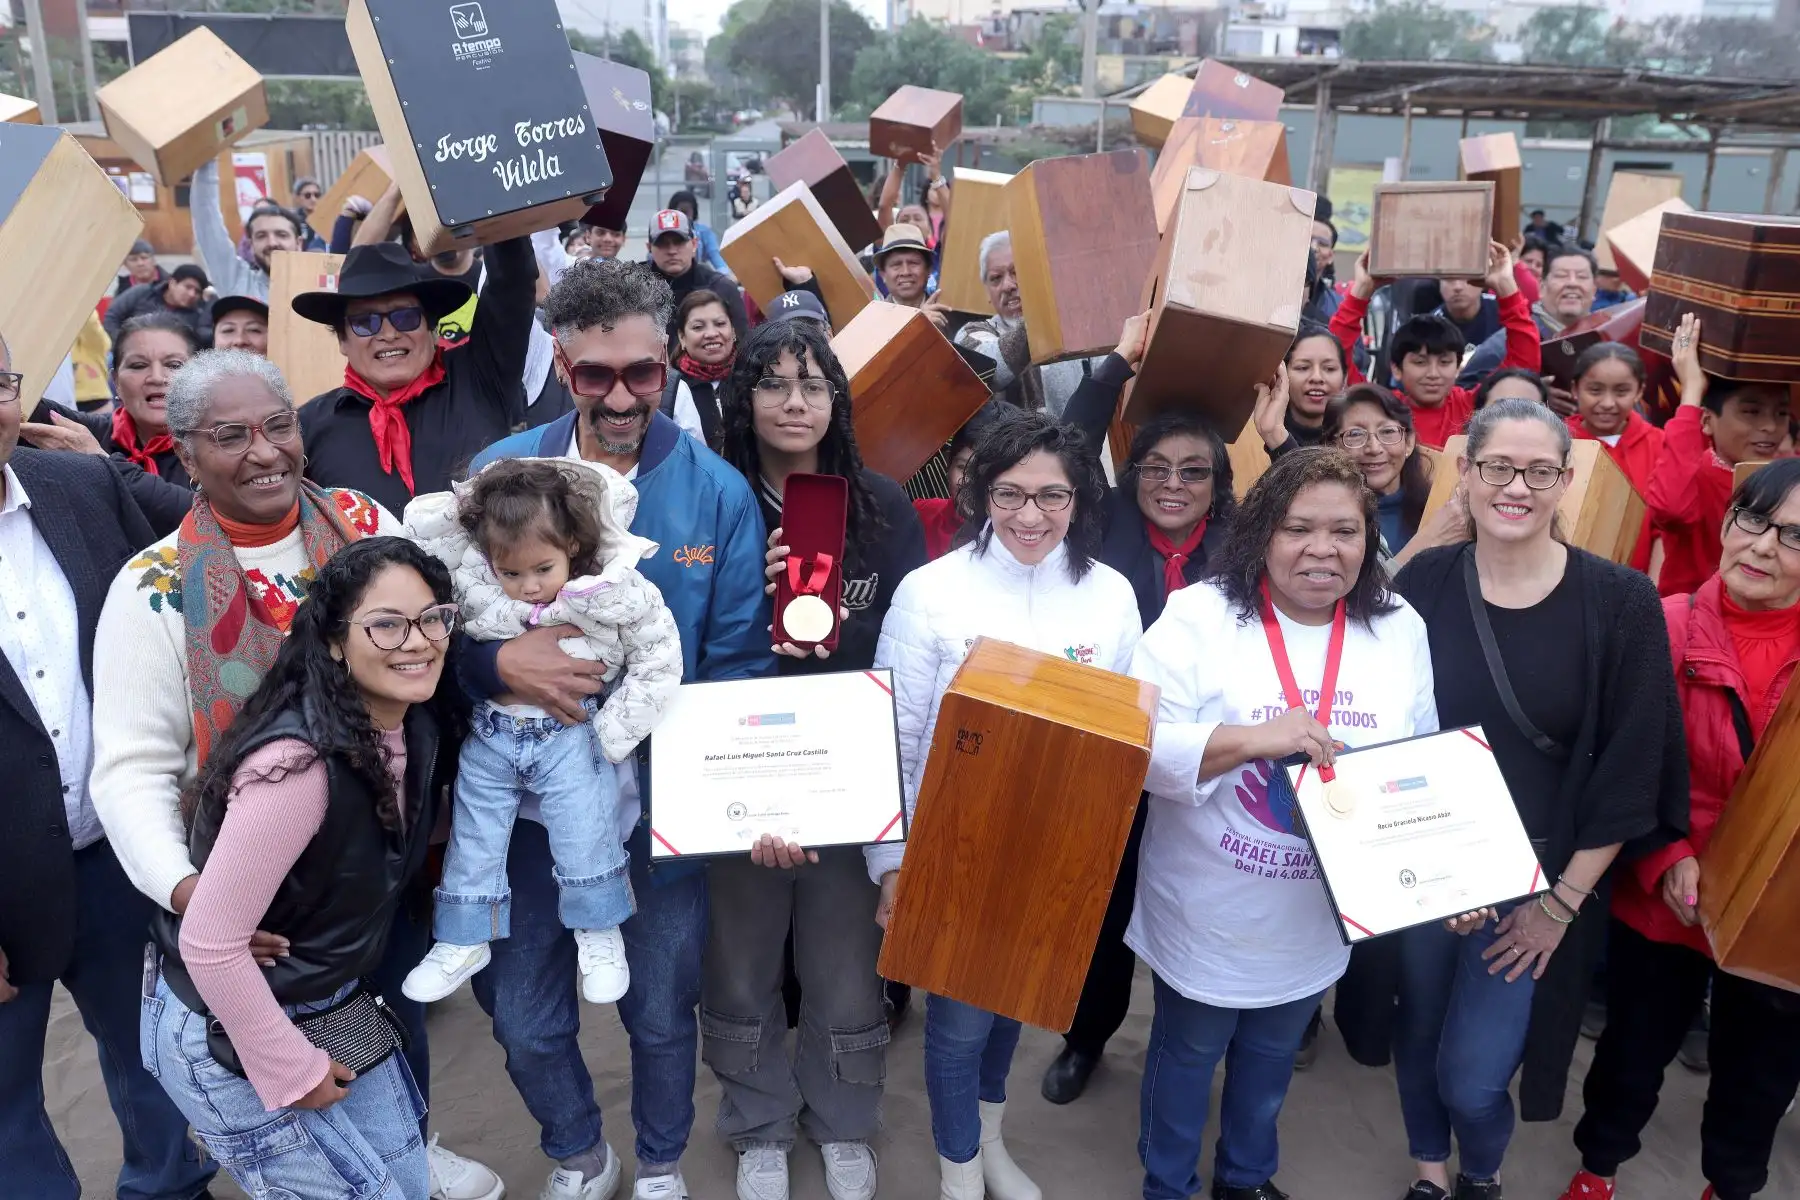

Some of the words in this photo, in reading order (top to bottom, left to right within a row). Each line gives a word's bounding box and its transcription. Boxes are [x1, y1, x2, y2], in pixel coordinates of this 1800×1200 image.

[462, 37, 501, 52] tempo
[434, 133, 498, 163] Jorge
[515, 113, 586, 147] Torres
[492, 149, 565, 191] Vilela
[742, 751, 765, 760] Miguel
[766, 750, 785, 758] Santa
[802, 748, 829, 756] Castillo
[1220, 833, 1278, 866] RAFAEL
[1226, 826, 1252, 843] FESTIVAL
[1253, 839, 1306, 853] INTERNACIONAL
[1234, 858, 1255, 873] Del
[1258, 865, 1263, 876] 1
[1265, 868, 1278, 879] al
